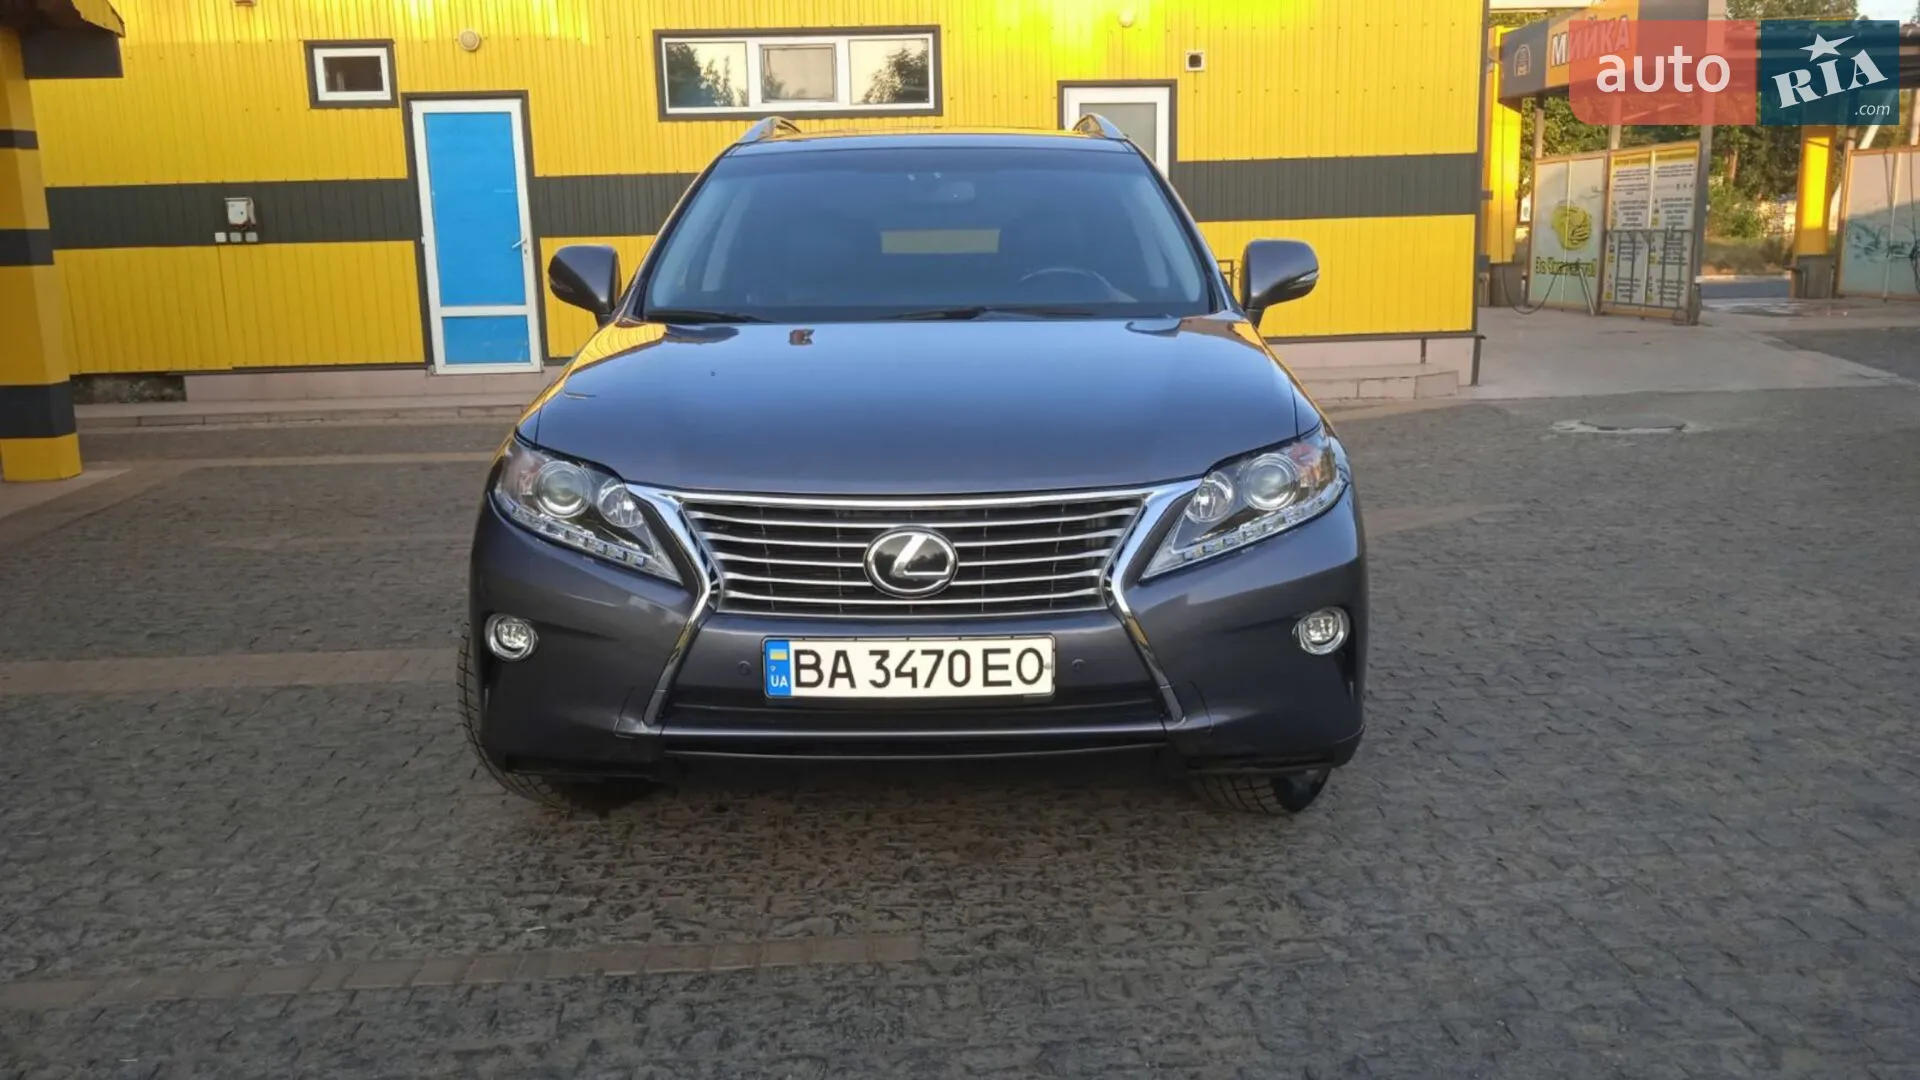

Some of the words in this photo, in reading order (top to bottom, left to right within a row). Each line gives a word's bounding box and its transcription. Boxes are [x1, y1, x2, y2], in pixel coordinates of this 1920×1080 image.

[770, 674, 789, 688] UA
[794, 648, 857, 688] BA
[868, 648, 972, 689] 3470
[982, 646, 1045, 687] EO
